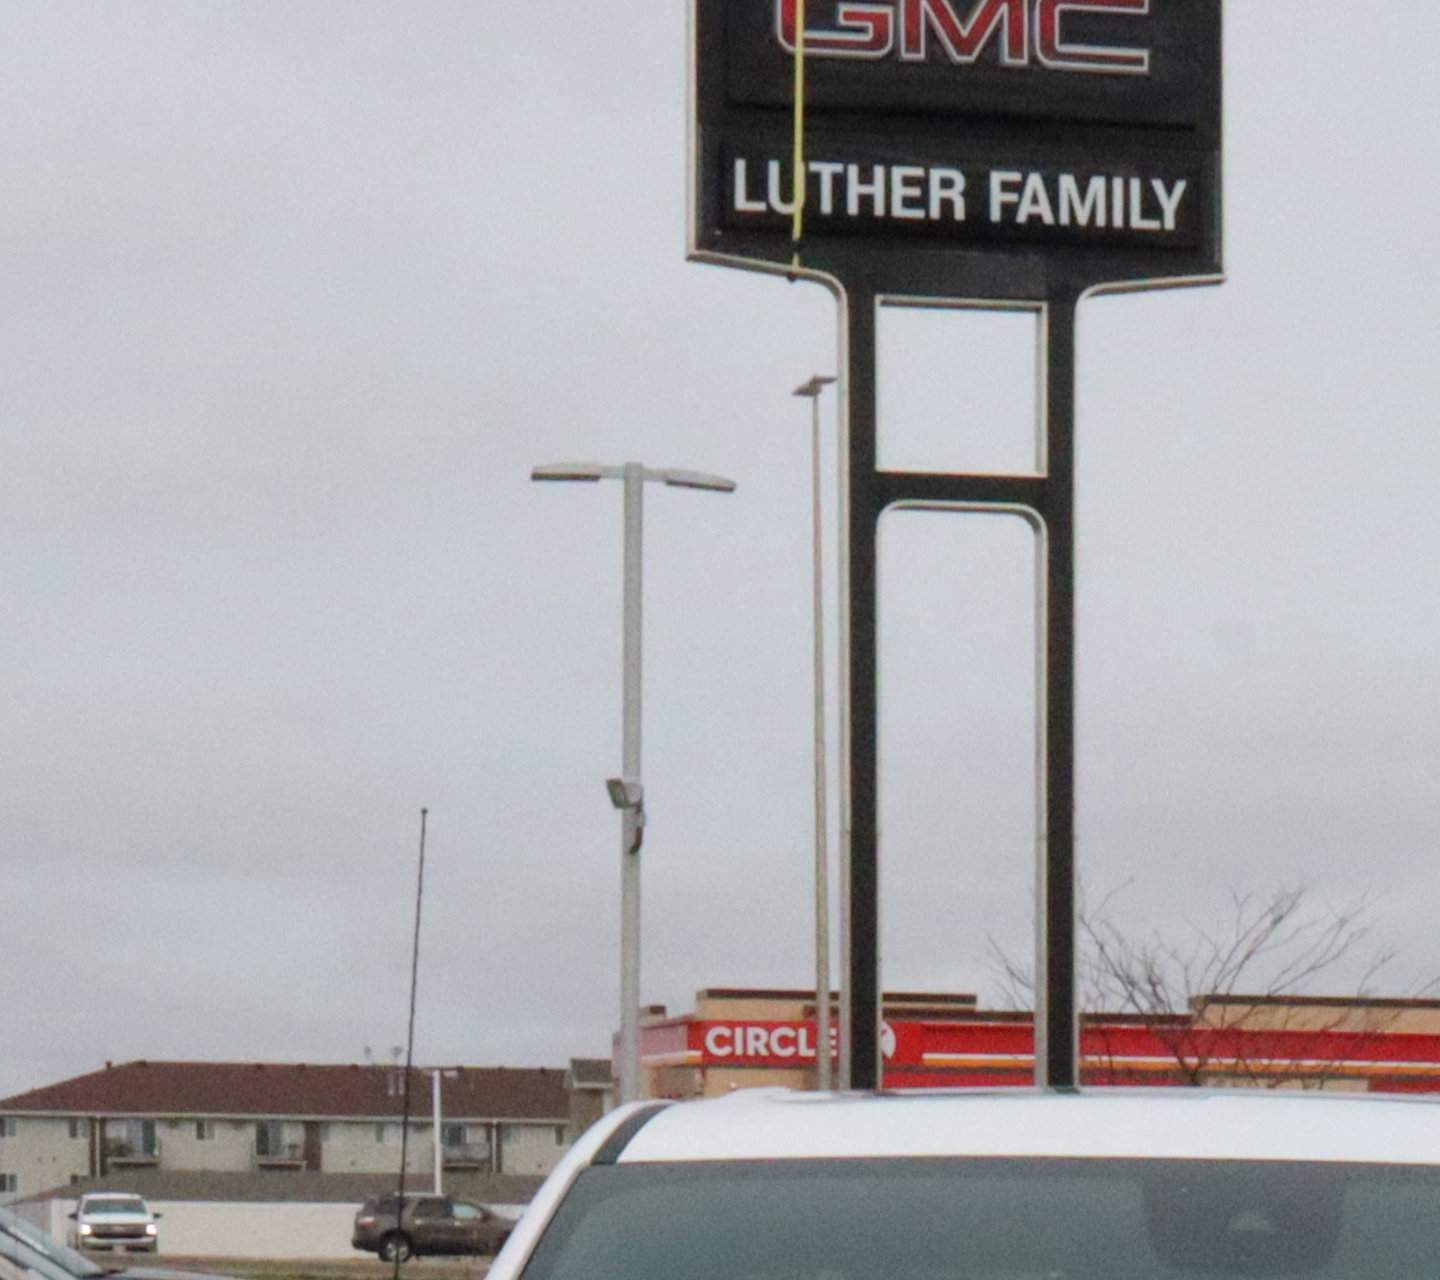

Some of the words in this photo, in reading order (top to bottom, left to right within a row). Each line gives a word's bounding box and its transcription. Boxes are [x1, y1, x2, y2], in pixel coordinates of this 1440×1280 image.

[772, 0, 1151, 74] GMC
[733, 158, 967, 220] LUTHER
[989, 171, 1187, 231] FAMILY
